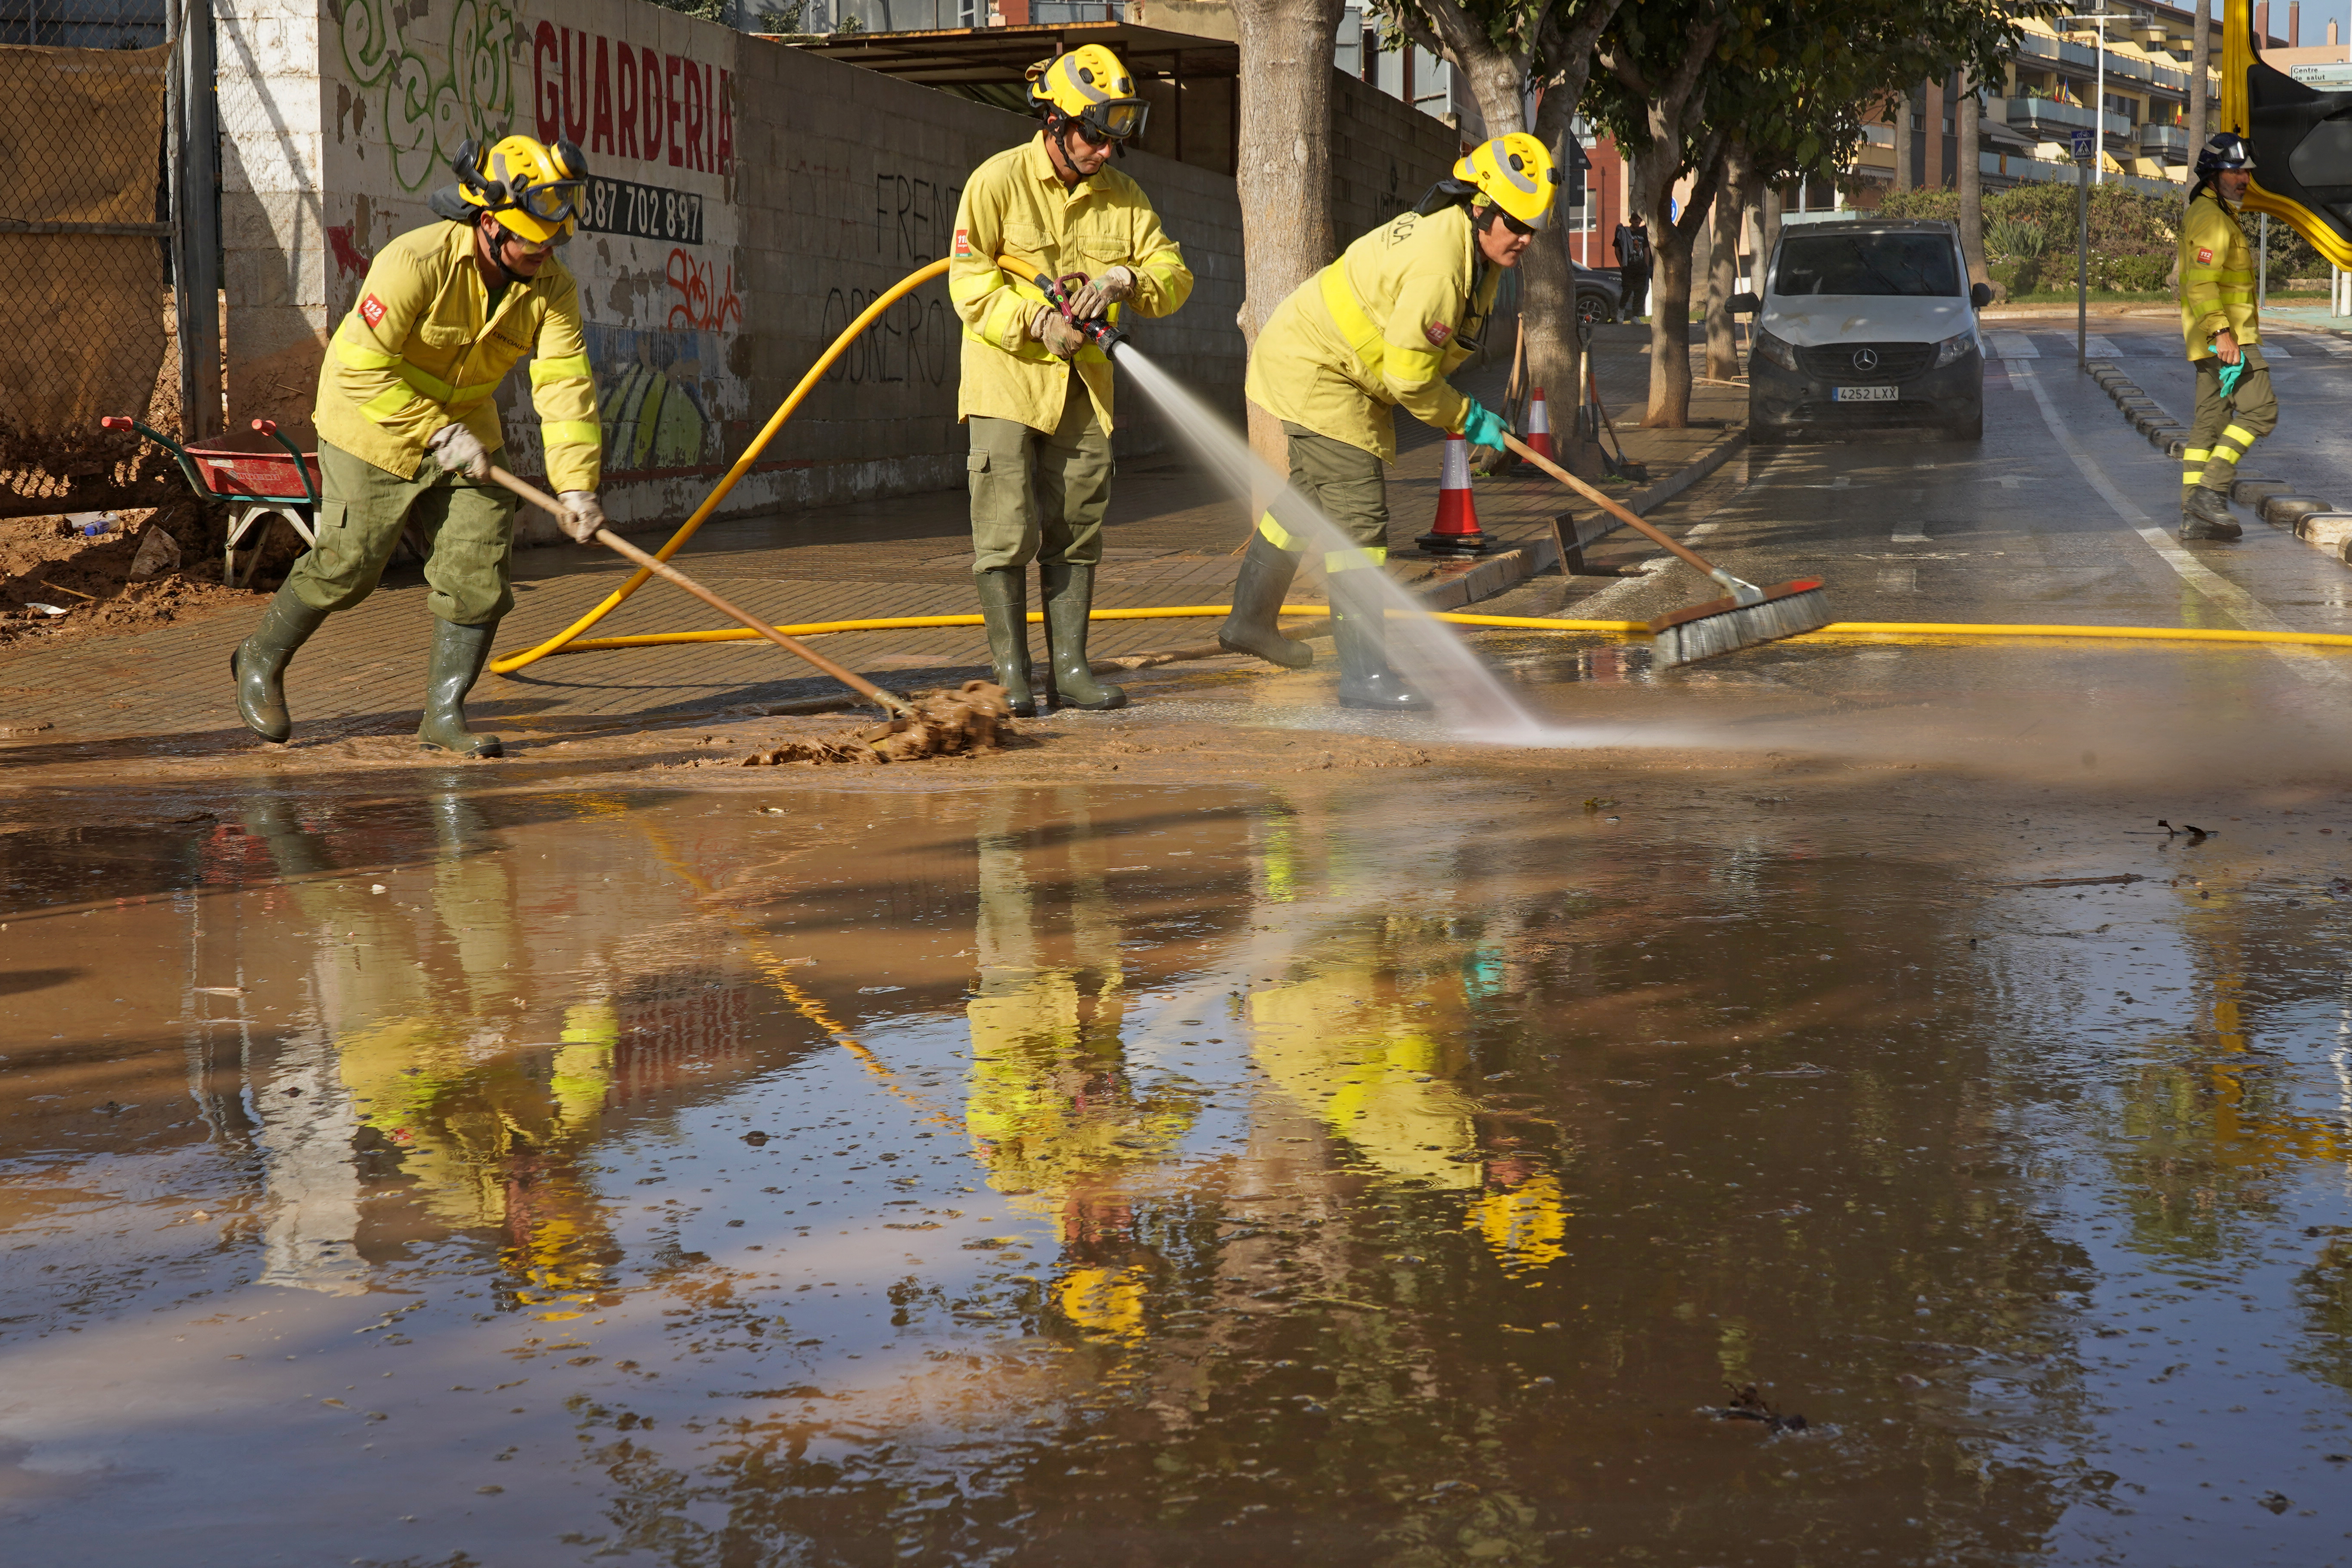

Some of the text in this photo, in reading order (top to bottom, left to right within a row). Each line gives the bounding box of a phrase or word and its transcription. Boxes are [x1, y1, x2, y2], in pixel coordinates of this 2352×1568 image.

[534, 20, 734, 175] GUARDERIA
[626, 185, 659, 236] 702
[666, 192, 699, 241] 897
[362, 300, 382, 317] 112
[822, 287, 945, 388] OBRERO
[1841, 389, 1870, 399] 4252
[1874, 389, 1896, 399] LXX
